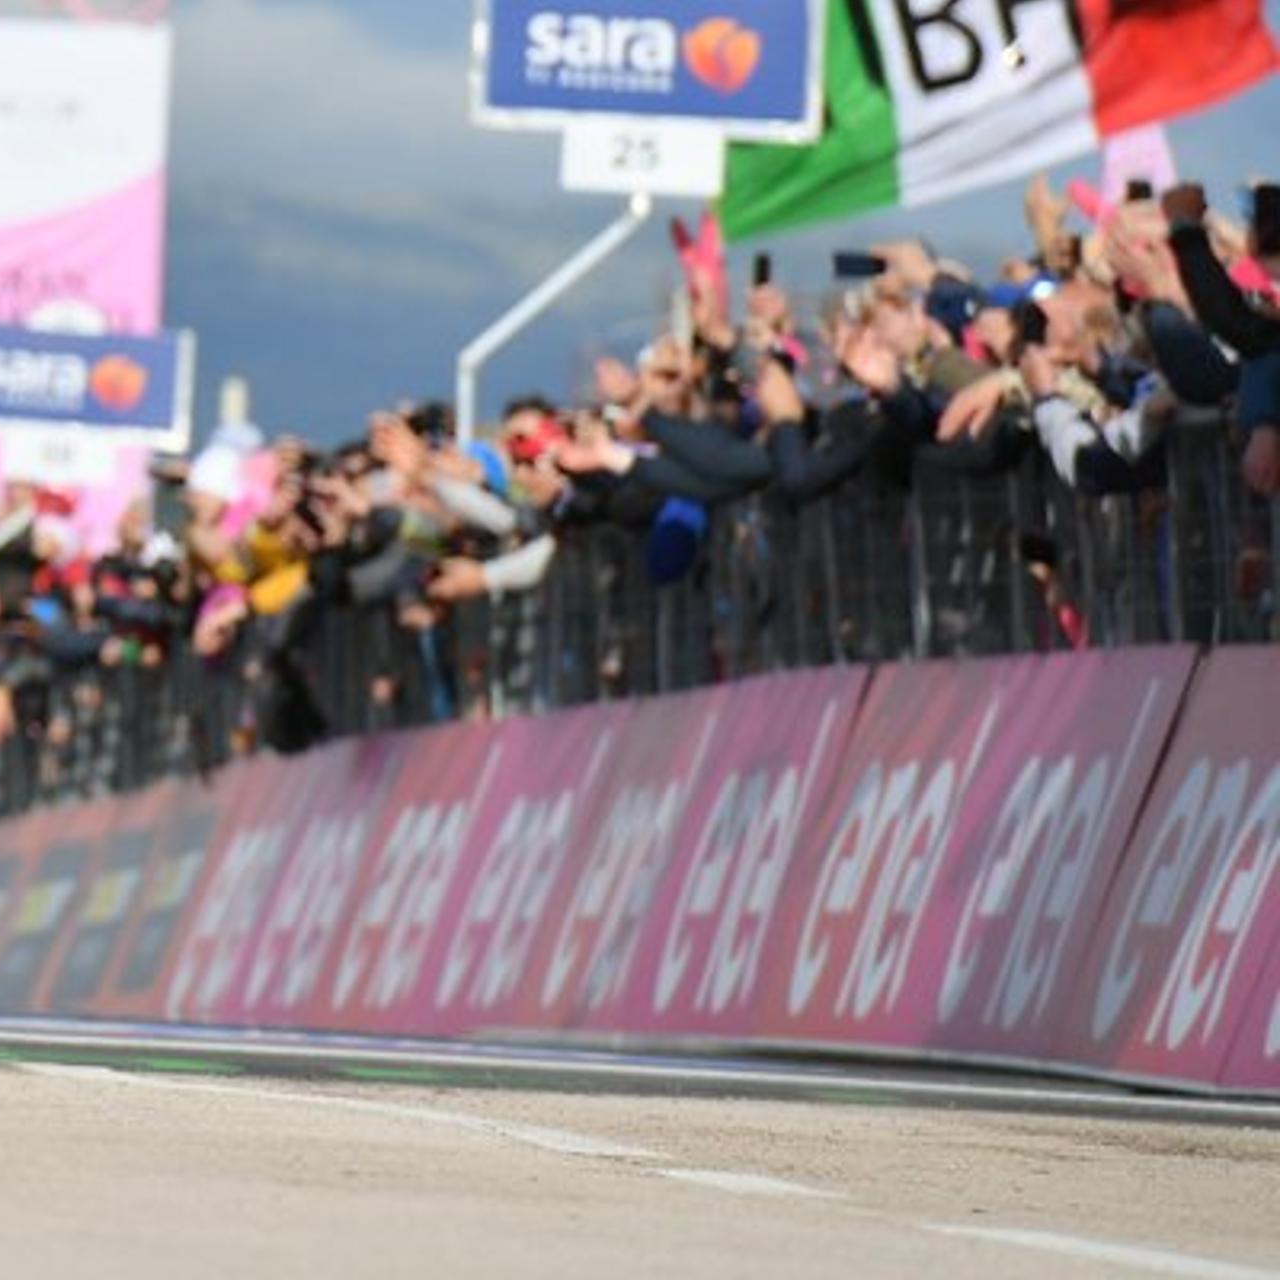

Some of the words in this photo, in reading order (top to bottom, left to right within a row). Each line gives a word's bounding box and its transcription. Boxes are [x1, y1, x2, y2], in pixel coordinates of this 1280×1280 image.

[524, 11, 677, 72] sara
[788, 690, 1000, 1019] enel
[939, 678, 1159, 1030] enel
